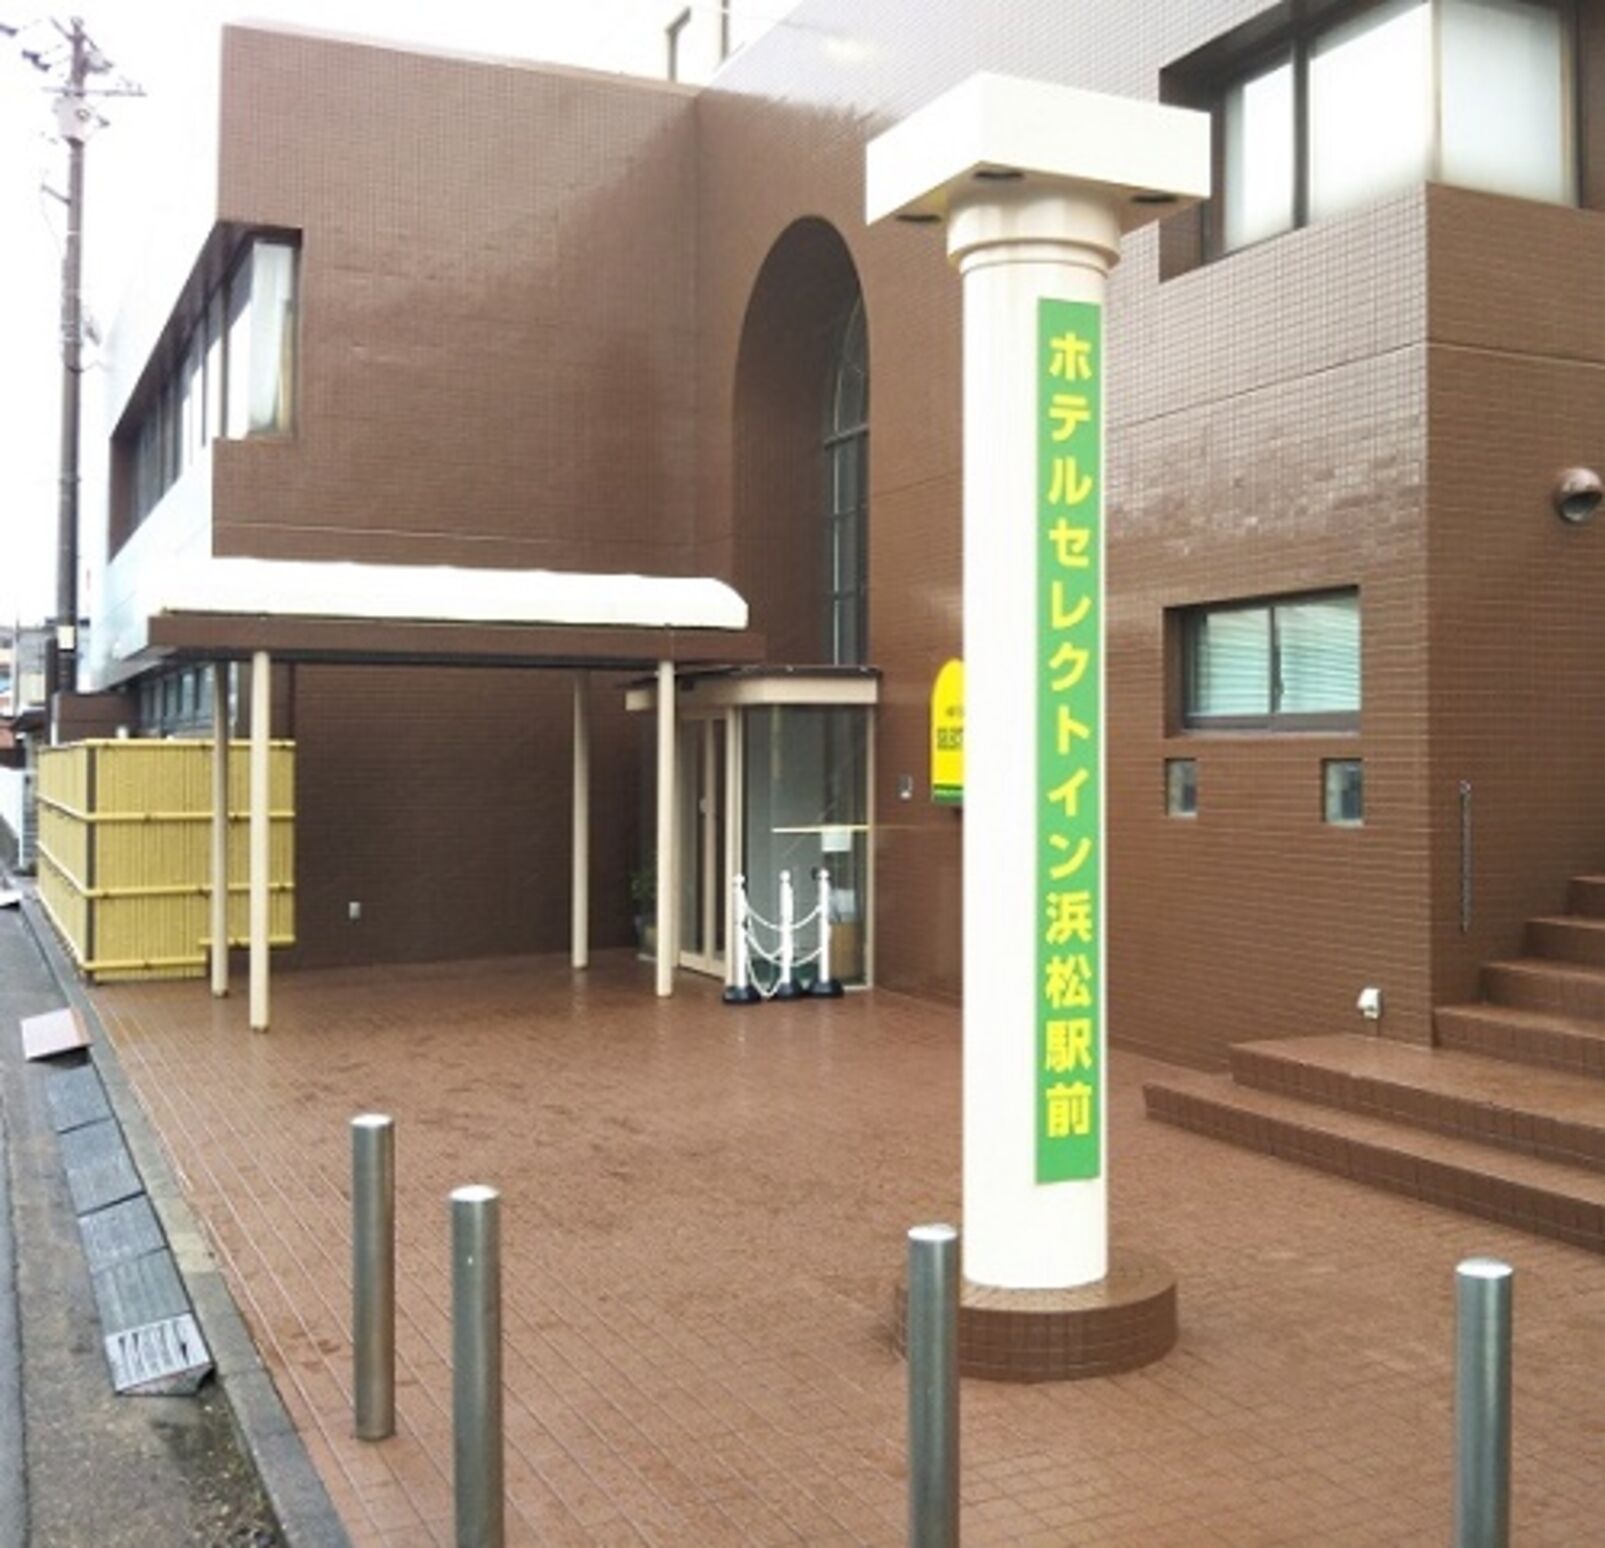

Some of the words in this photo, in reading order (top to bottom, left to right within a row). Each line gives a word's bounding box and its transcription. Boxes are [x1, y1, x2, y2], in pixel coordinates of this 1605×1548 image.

[1046, 332, 1092, 1138] ホテルセレクトイン浜松駅前
